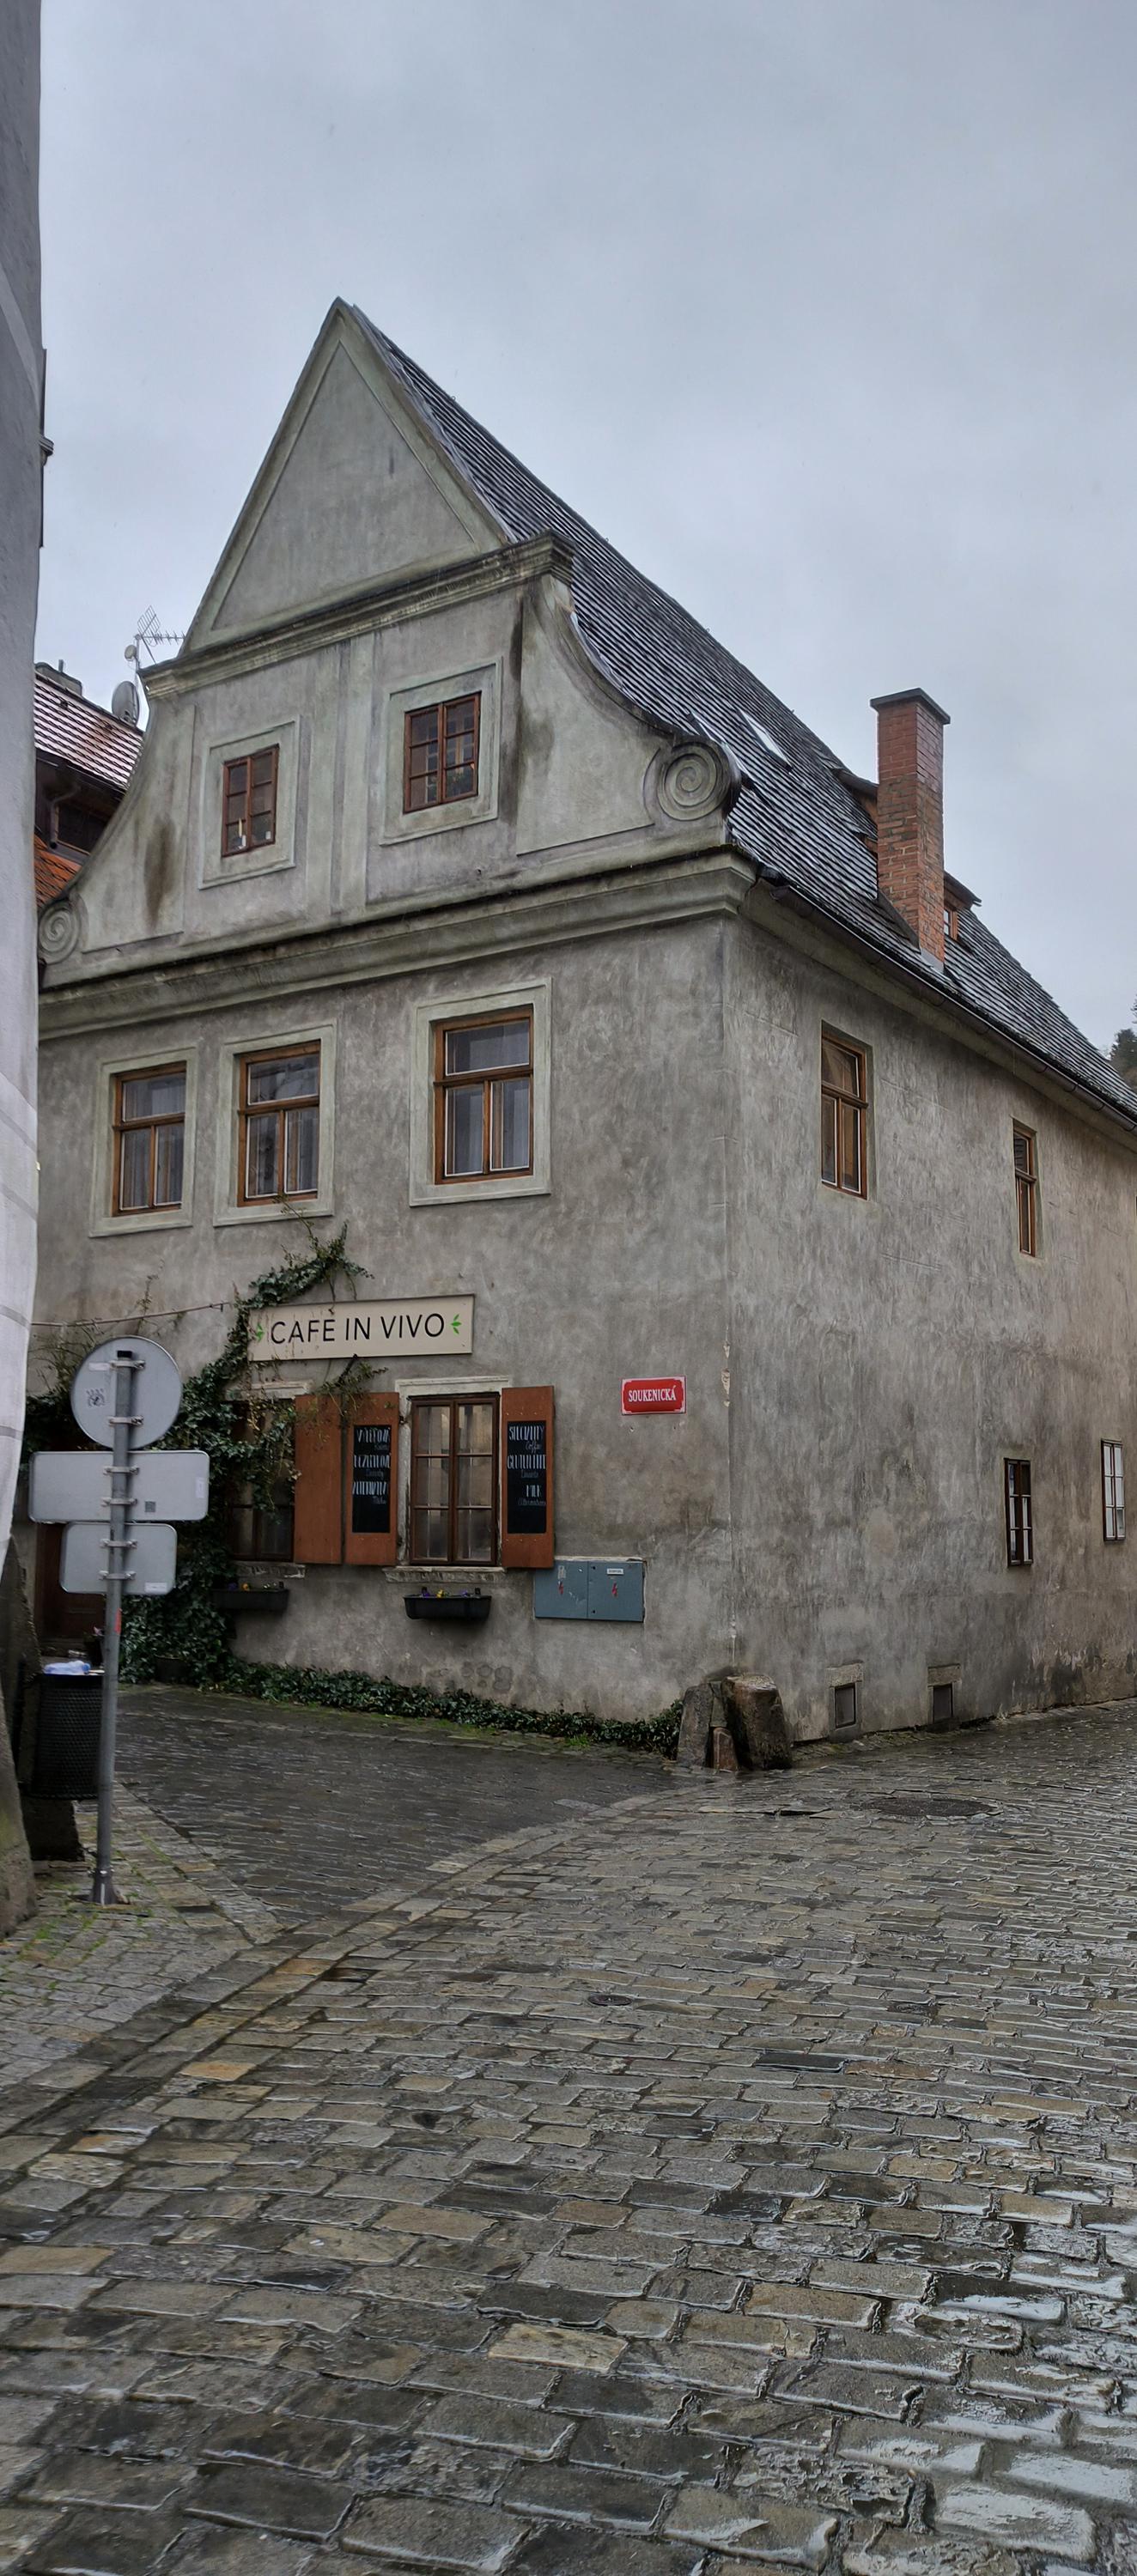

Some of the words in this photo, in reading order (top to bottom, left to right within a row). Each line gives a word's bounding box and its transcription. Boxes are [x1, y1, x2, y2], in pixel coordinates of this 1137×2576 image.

[271, 1319, 336, 1345] CAFE
[345, 1316, 371, 1340] IN
[380, 1313, 445, 1338] VIVO
[628, 1384, 677, 1402] SOUKENICKÁ
